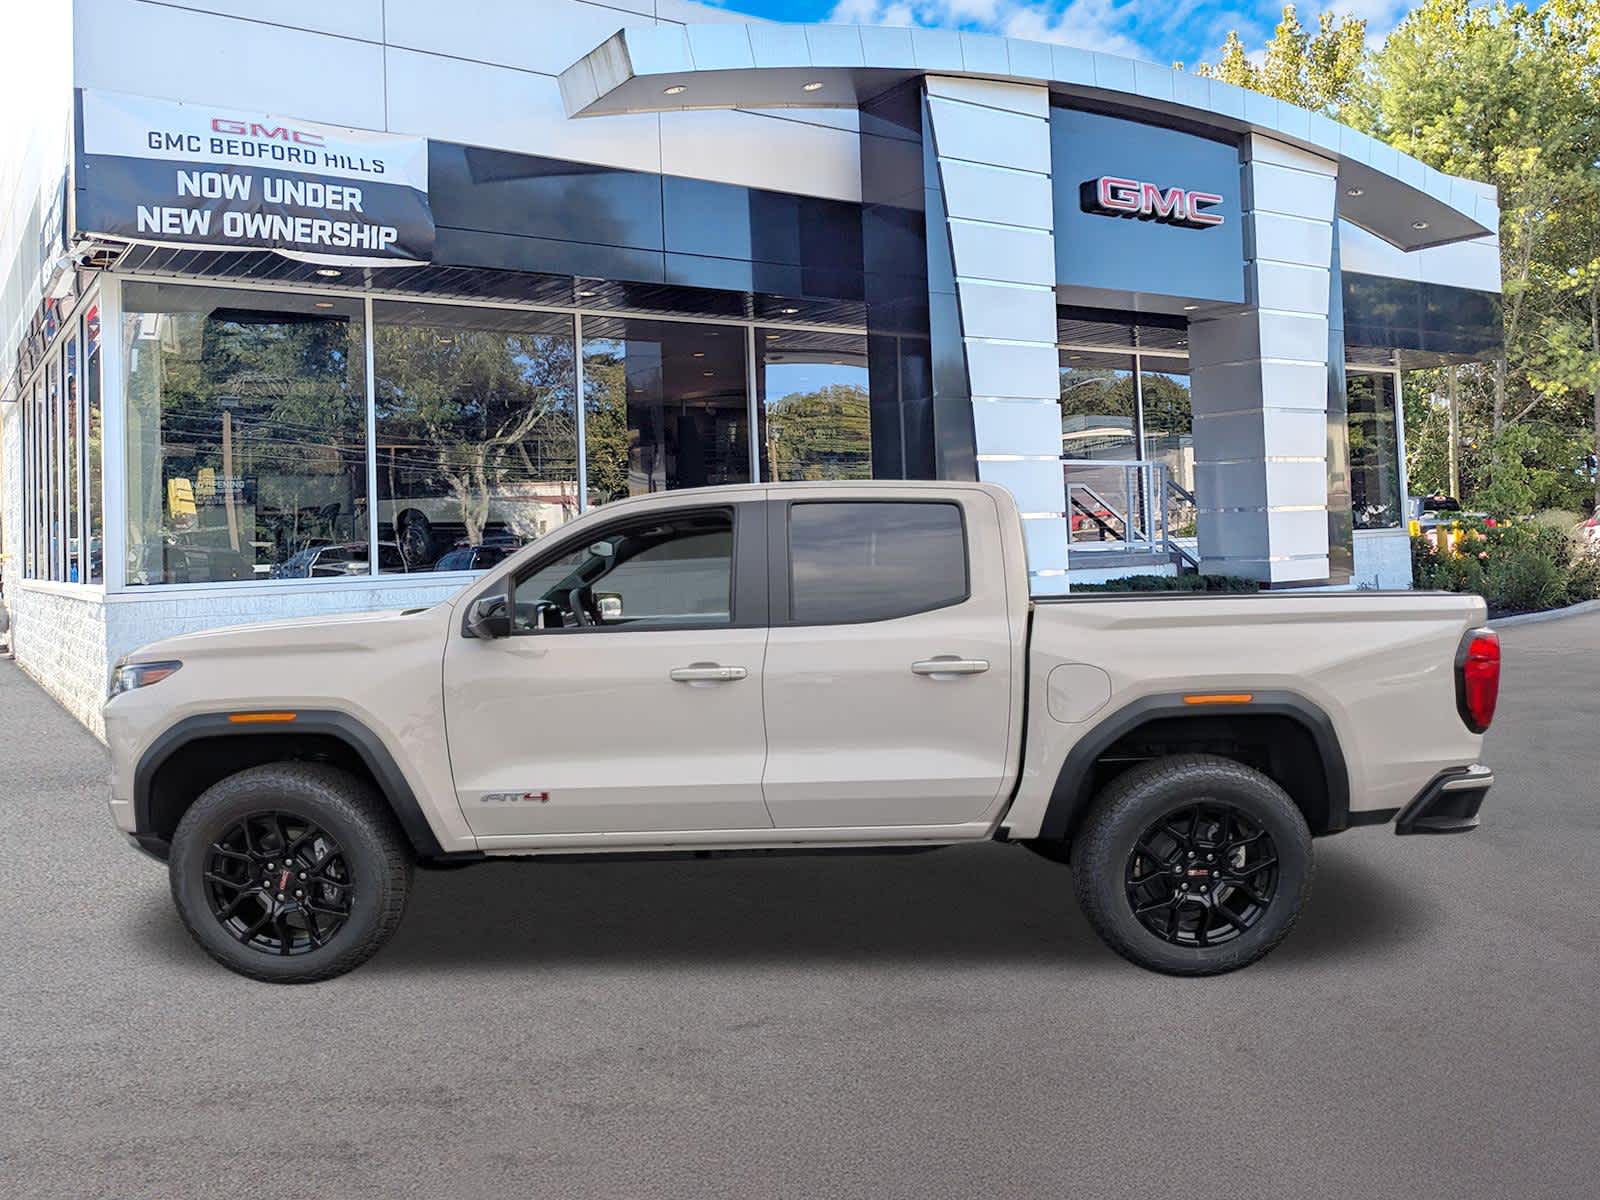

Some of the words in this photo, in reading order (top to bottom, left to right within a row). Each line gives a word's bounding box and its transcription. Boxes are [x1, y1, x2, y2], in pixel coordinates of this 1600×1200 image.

[148, 131, 201, 152] GMC
[210, 139, 317, 165] BEDFORD
[324, 154, 385, 174] HILLS
[211, 118, 325, 146] GMC
[177, 170, 252, 200] NOW
[264, 177, 363, 212] UNDER
[1097, 176, 1225, 224] GMC
[137, 205, 209, 236] NEW
[223, 211, 398, 250] OWNERSHIP
[480, 792, 549, 803] AT4
